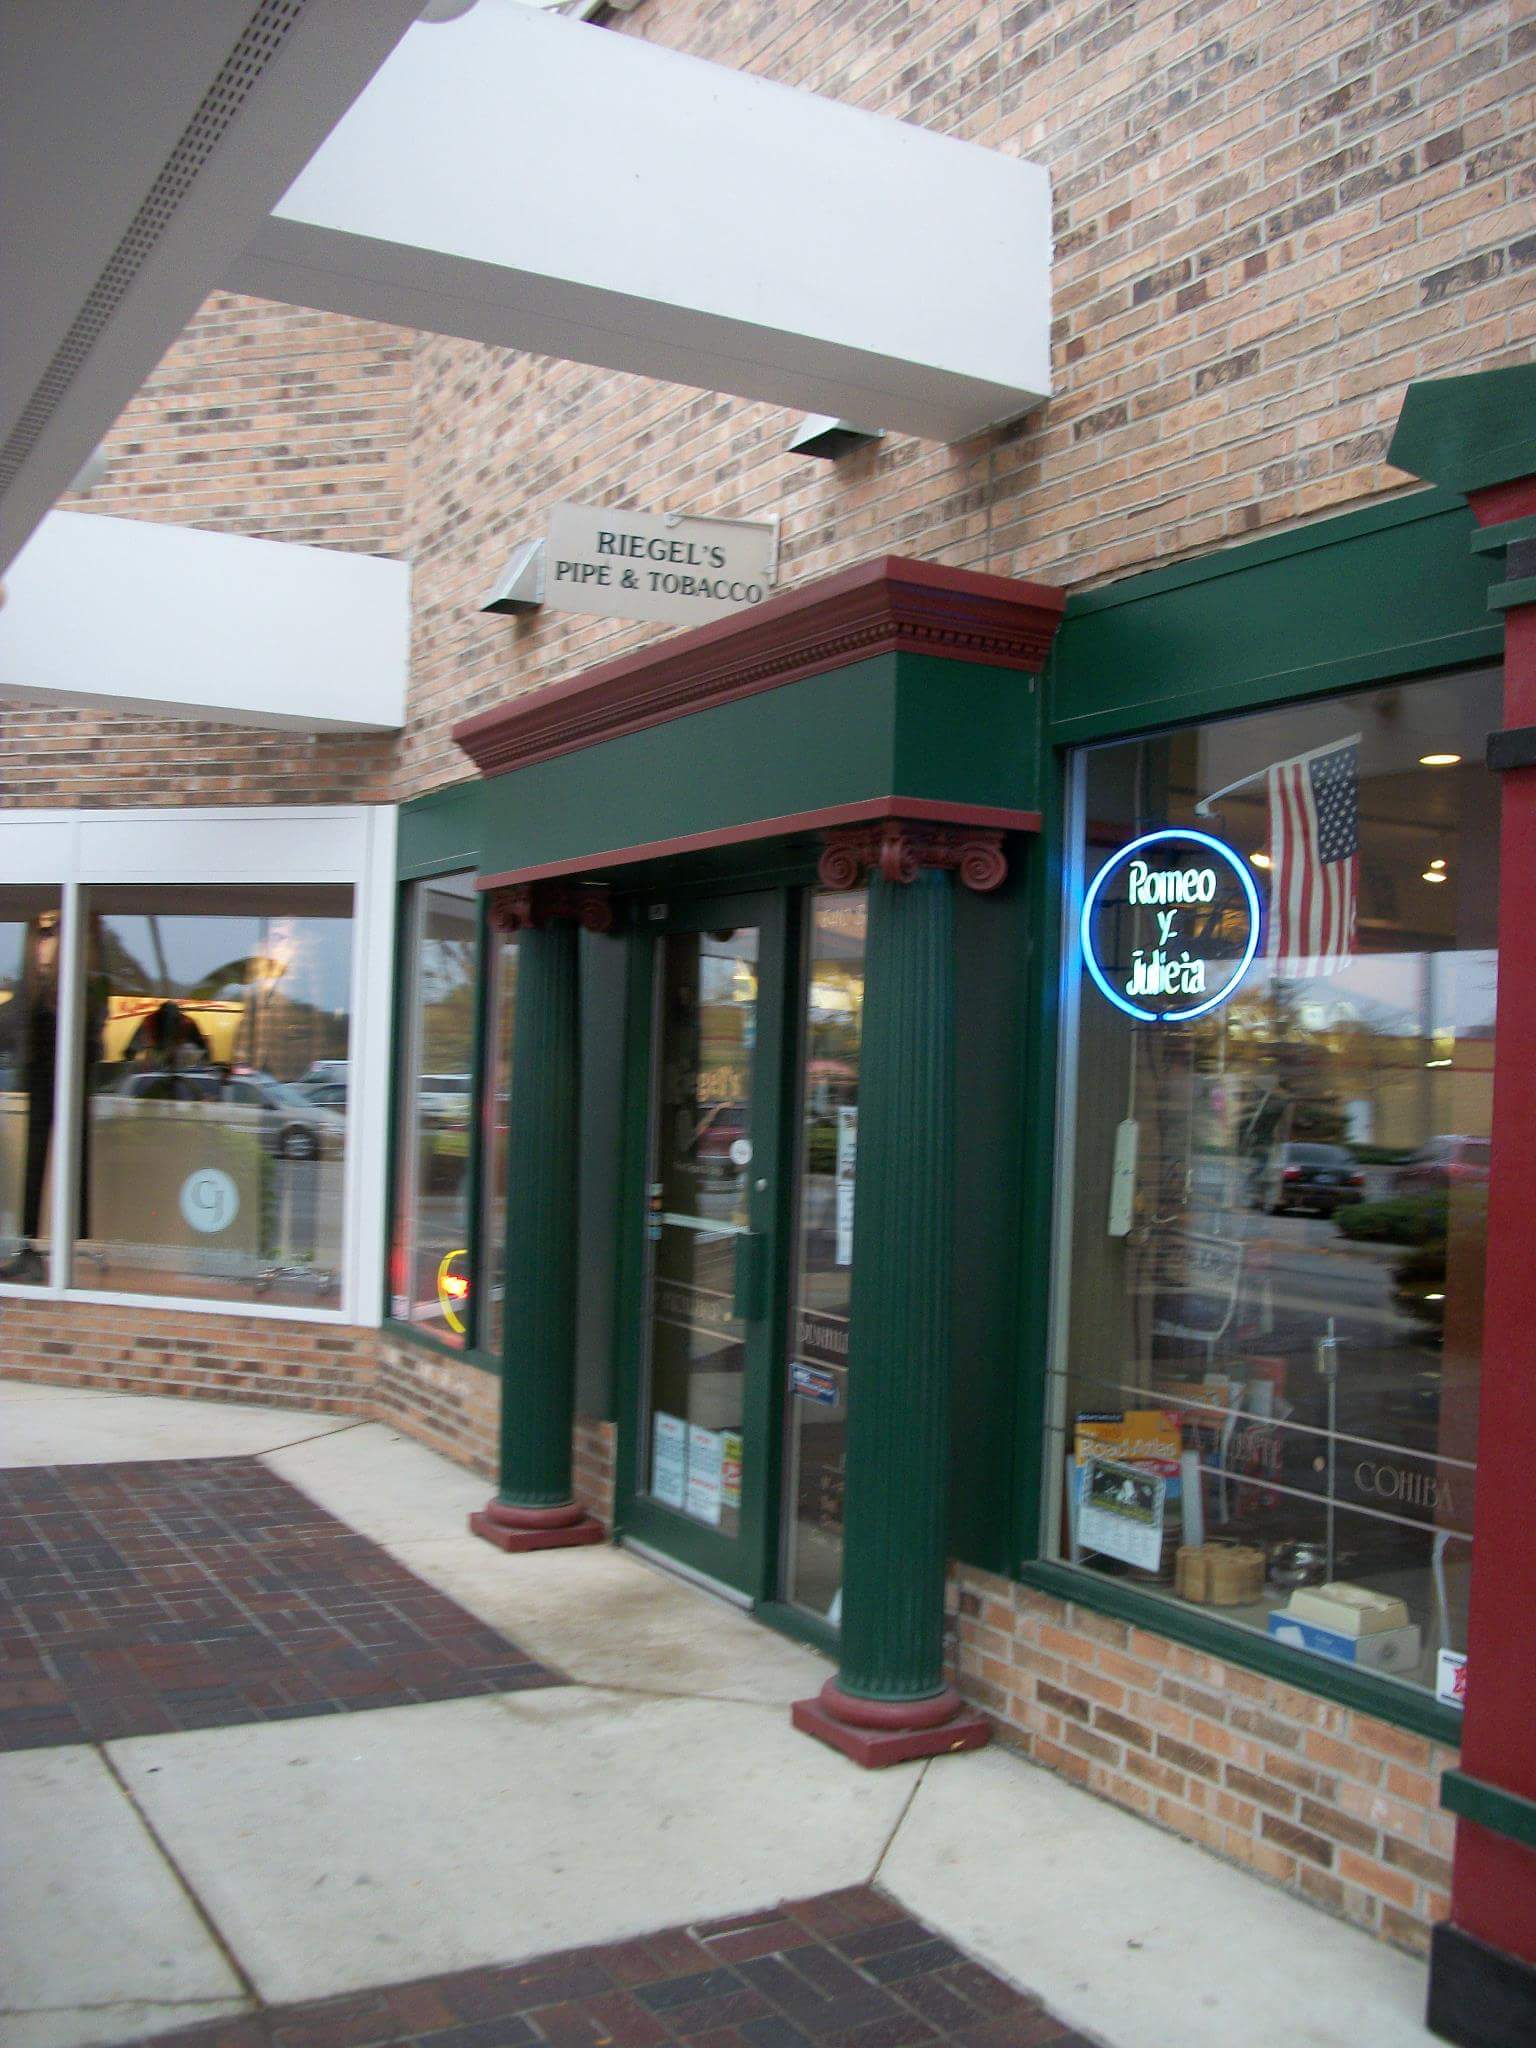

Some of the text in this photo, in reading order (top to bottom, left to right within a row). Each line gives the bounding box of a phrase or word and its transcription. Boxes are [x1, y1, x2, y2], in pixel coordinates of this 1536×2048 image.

[597, 531, 726, 569] RIEGEL'S
[555, 560, 762, 604] PIPE & TOBACCO
[1128, 860, 1217, 905] Romeo
[1081, 1437, 1129, 1457] Road
[1354, 1461, 1456, 1515] COHIBA
